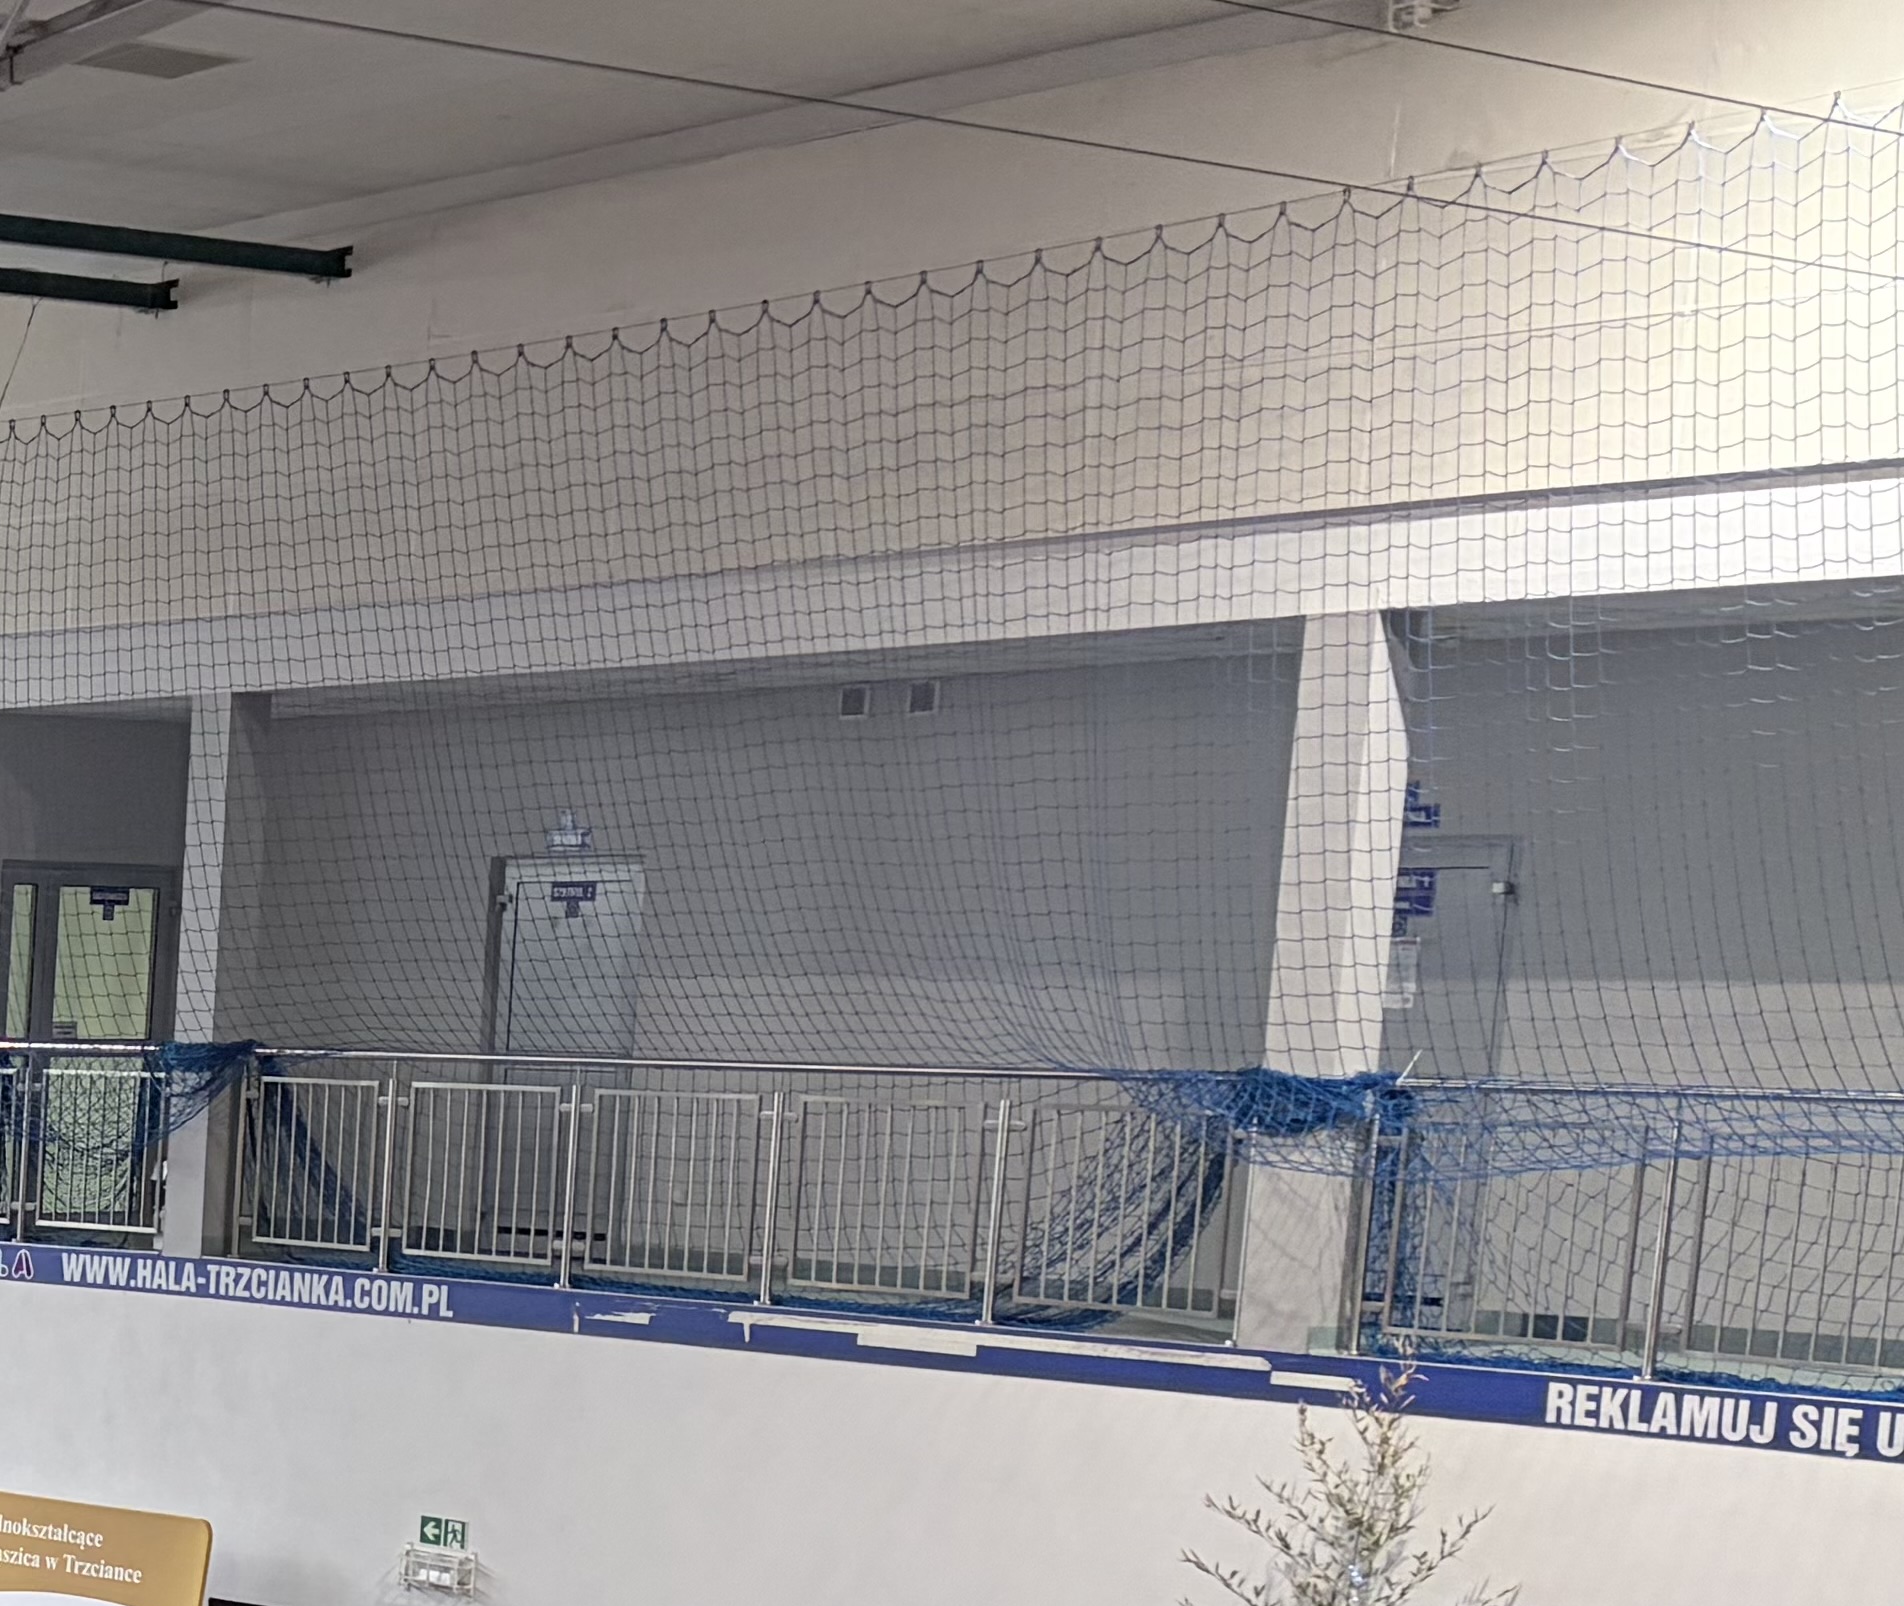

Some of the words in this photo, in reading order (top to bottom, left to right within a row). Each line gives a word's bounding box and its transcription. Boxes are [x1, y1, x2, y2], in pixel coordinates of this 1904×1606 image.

[61, 1252, 454, 1319] WWW.HALA-TRZCIANKA.COM.PL
[1545, 1381, 1780, 1448] REKLAMUJ
[1790, 1394, 1860, 1458] SIĘ
[44, 1556, 59, 1571] w
[63, 1553, 143, 1585] Trzciance
